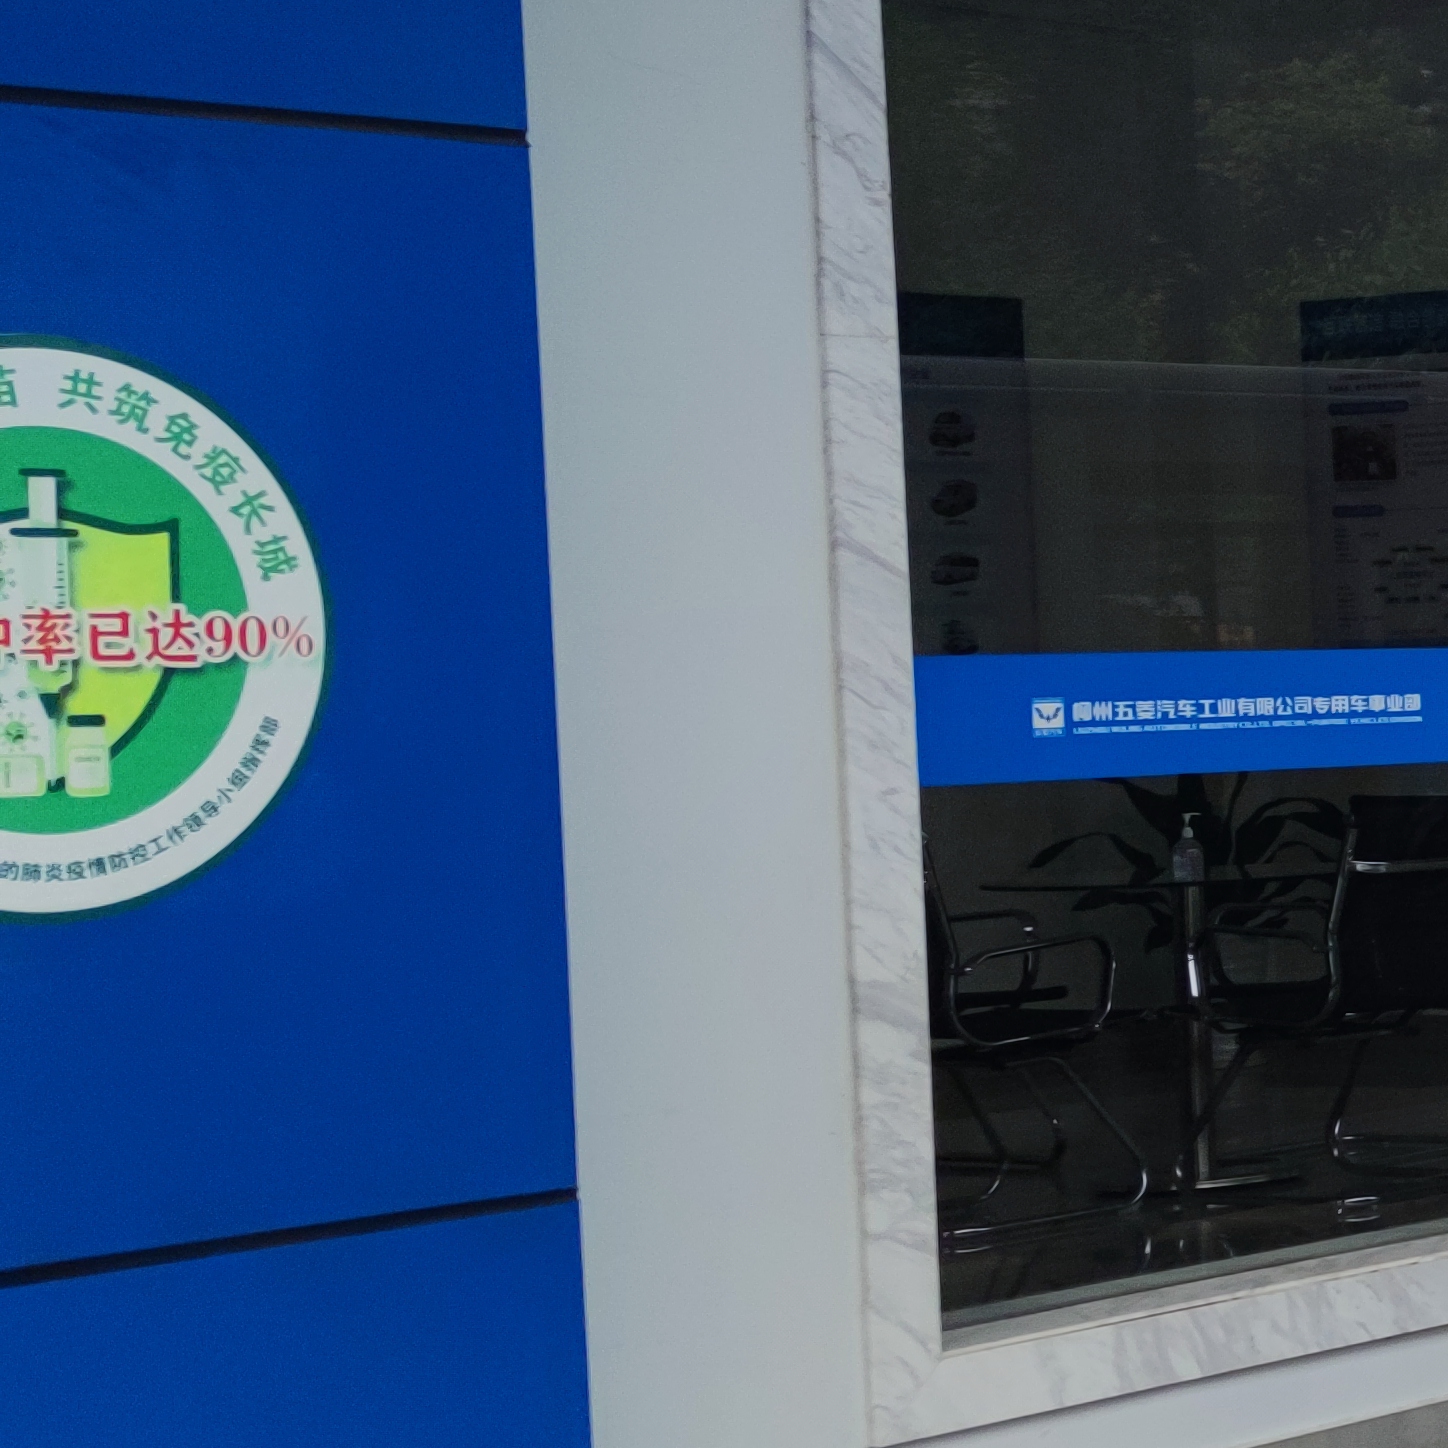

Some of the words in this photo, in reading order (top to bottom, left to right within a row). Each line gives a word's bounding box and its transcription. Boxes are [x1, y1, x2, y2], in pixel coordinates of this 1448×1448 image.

[58, 369, 300, 582] 共筑免疫长城
[0, 607, 313, 665] 率已达90%
